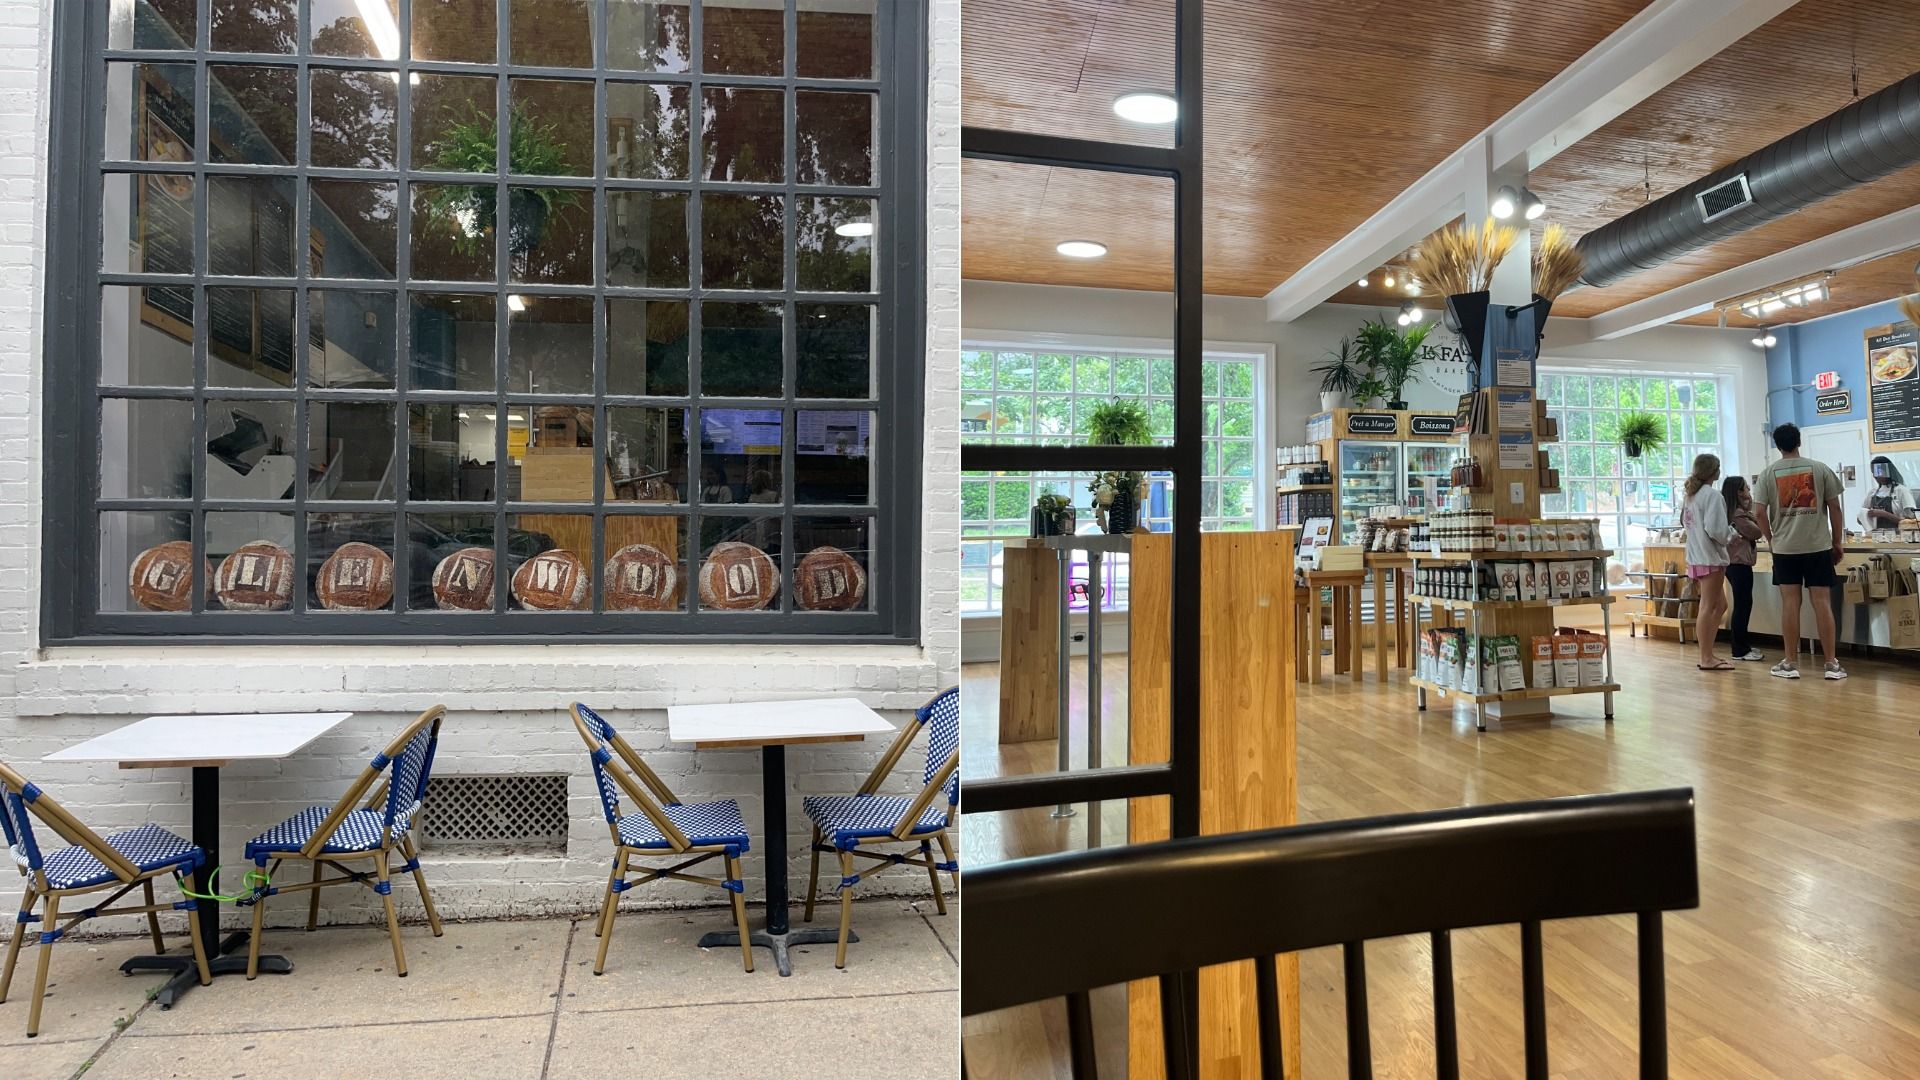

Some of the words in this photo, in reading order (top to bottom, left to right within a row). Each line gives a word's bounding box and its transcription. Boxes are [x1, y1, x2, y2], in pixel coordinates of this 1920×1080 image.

[1440, 346, 1468, 363] FA
[1436, 366, 1465, 375] BAKE
[1818, 372, 1833, 389] EXIT
[1370, 420, 1395, 429] Manger
[1419, 421, 1451, 430] Boissons
